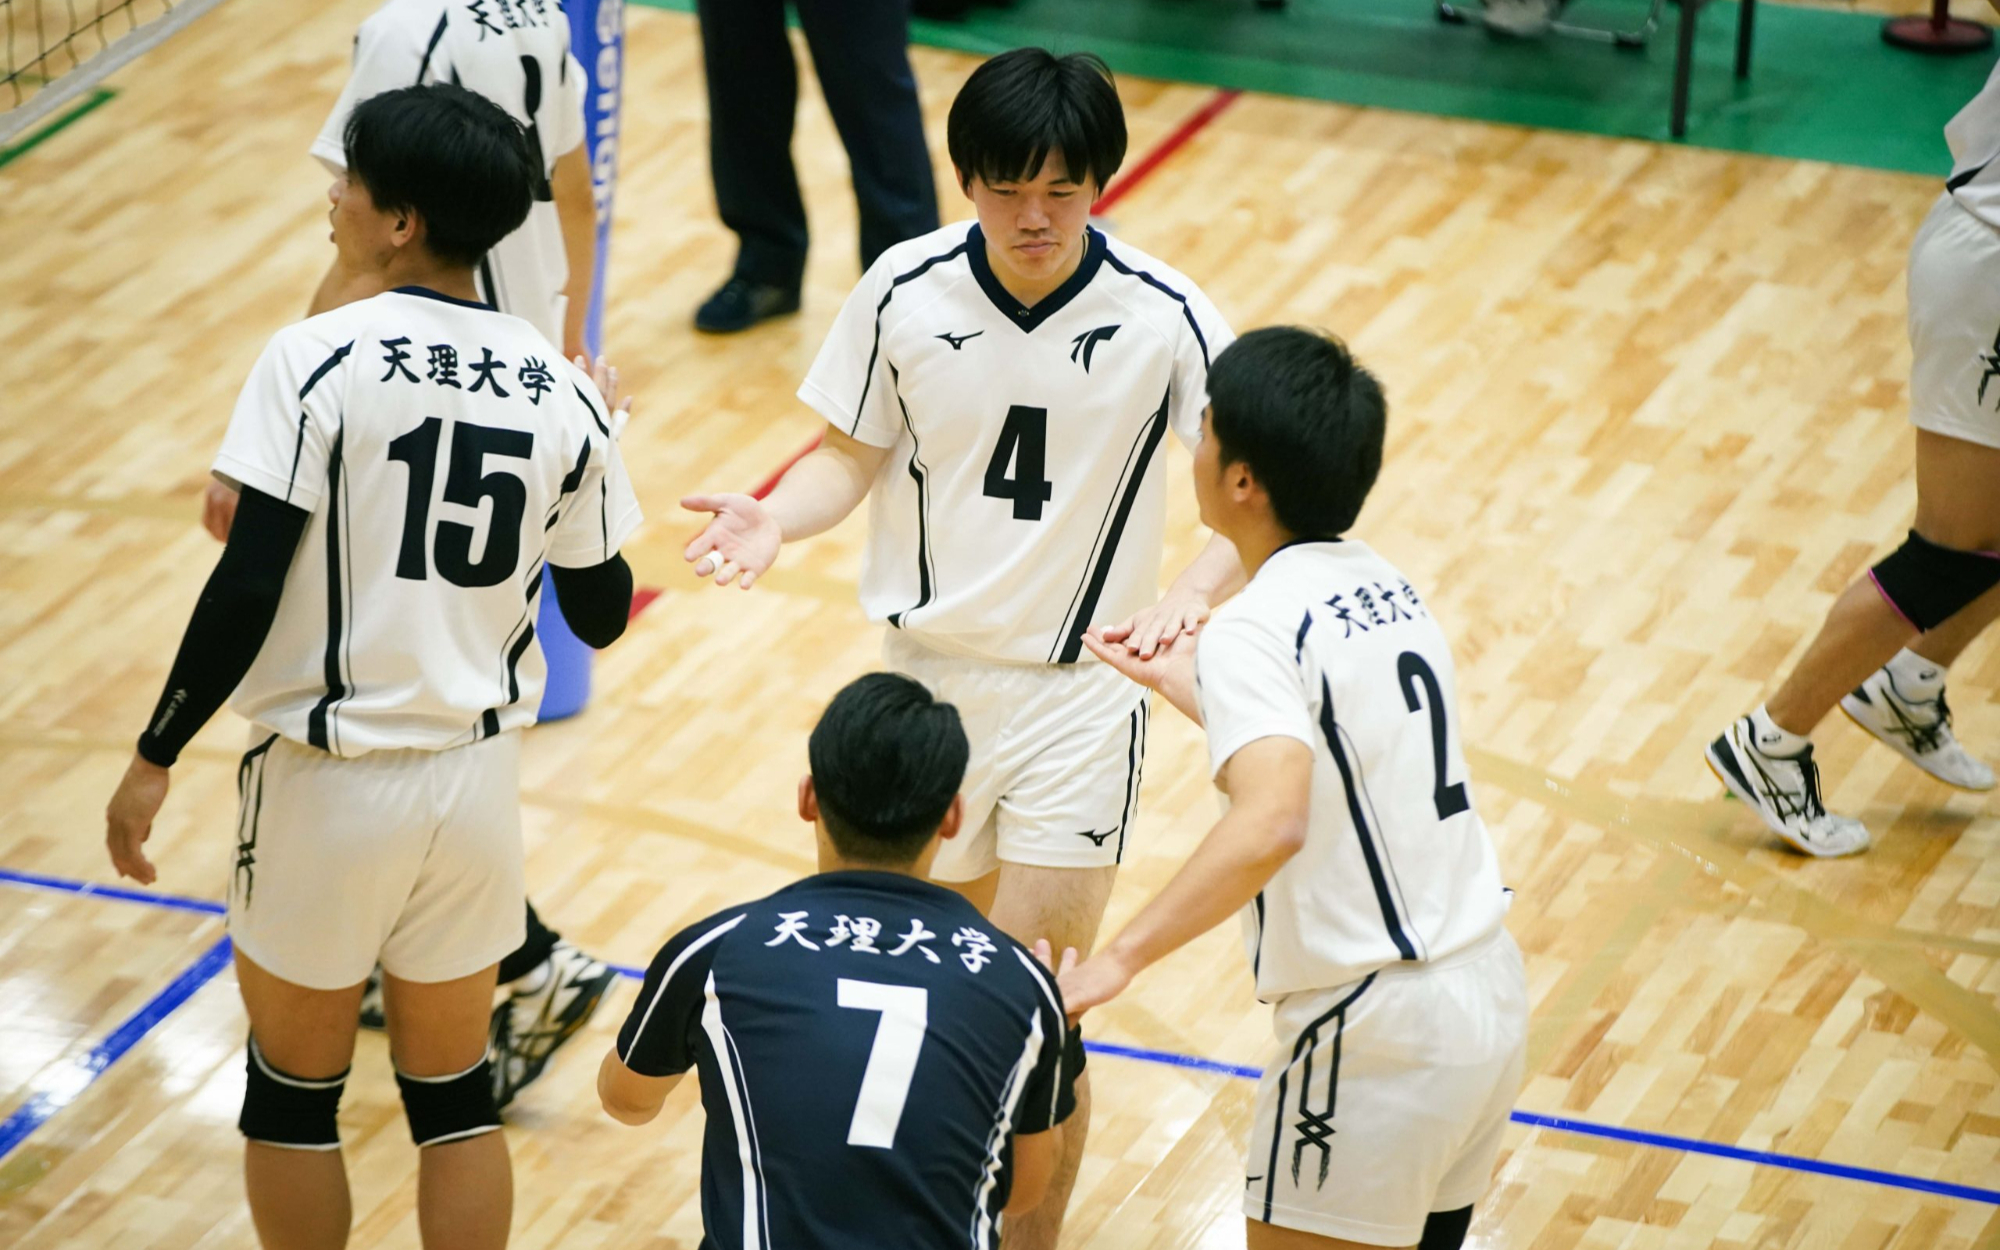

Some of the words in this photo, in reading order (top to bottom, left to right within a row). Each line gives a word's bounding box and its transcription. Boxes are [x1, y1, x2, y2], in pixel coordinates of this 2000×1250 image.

[379, 335, 556, 406] 天理大学
[387, 416, 534, 589] 15
[982, 405, 1053, 521] 4
[1396, 650, 1471, 821] 2
[764, 910, 998, 974] 天理大学
[836, 977, 929, 1150] 7
